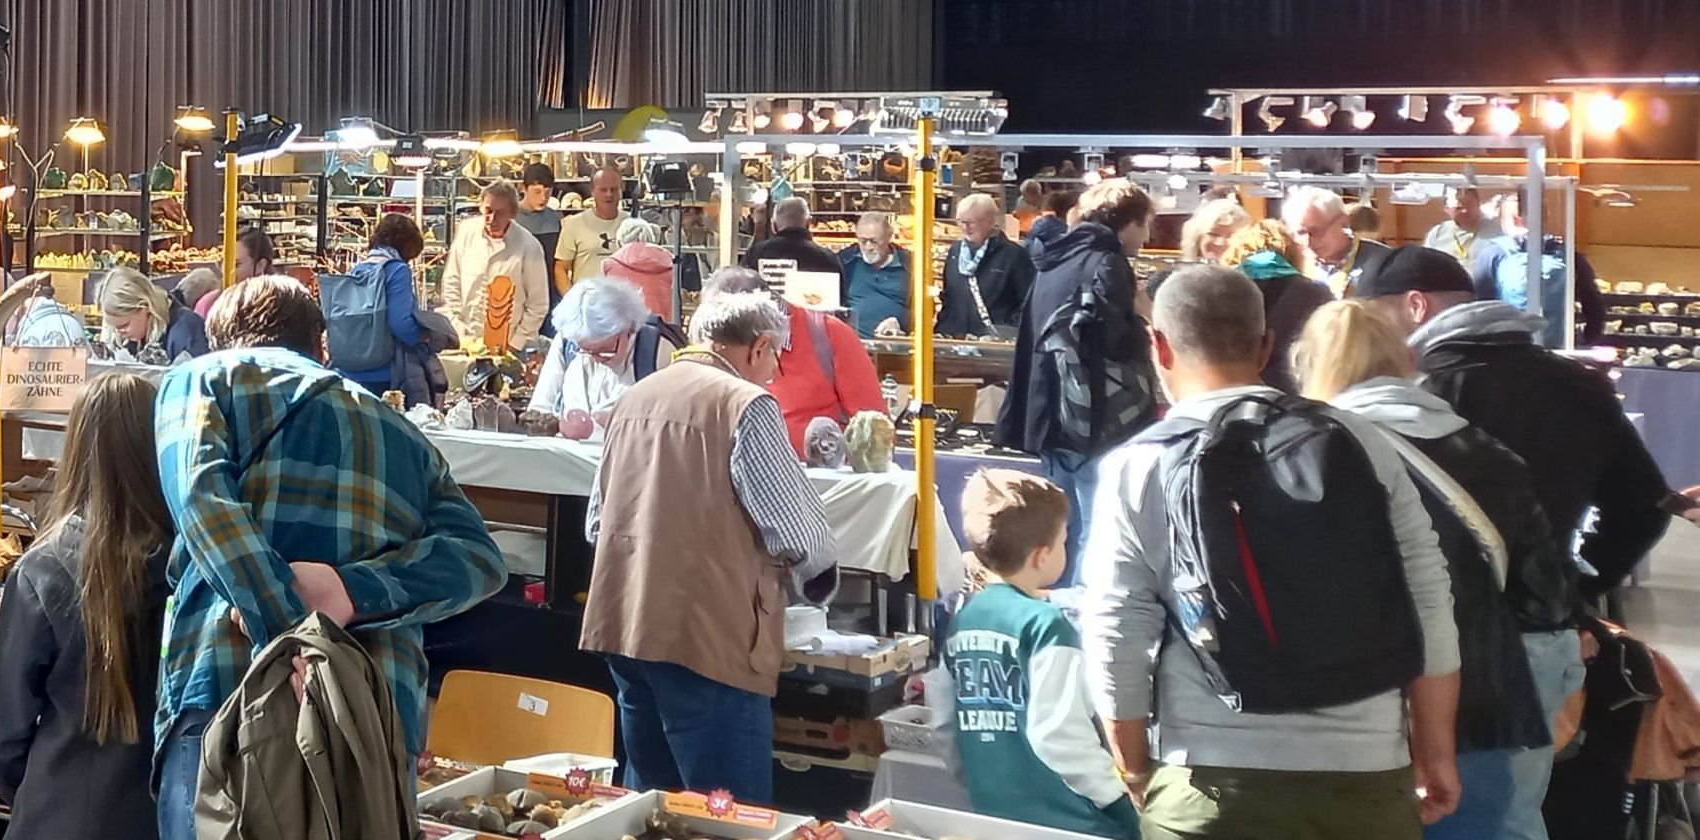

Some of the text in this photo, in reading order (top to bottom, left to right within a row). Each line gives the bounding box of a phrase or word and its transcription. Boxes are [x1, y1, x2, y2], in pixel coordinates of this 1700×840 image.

[28, 361, 64, 372] ECHTE
[7, 374, 84, 385] DINOSAURIER-
[27, 385, 63, 397] ZÄHNE
[568, 776, 587, 788] 10€
